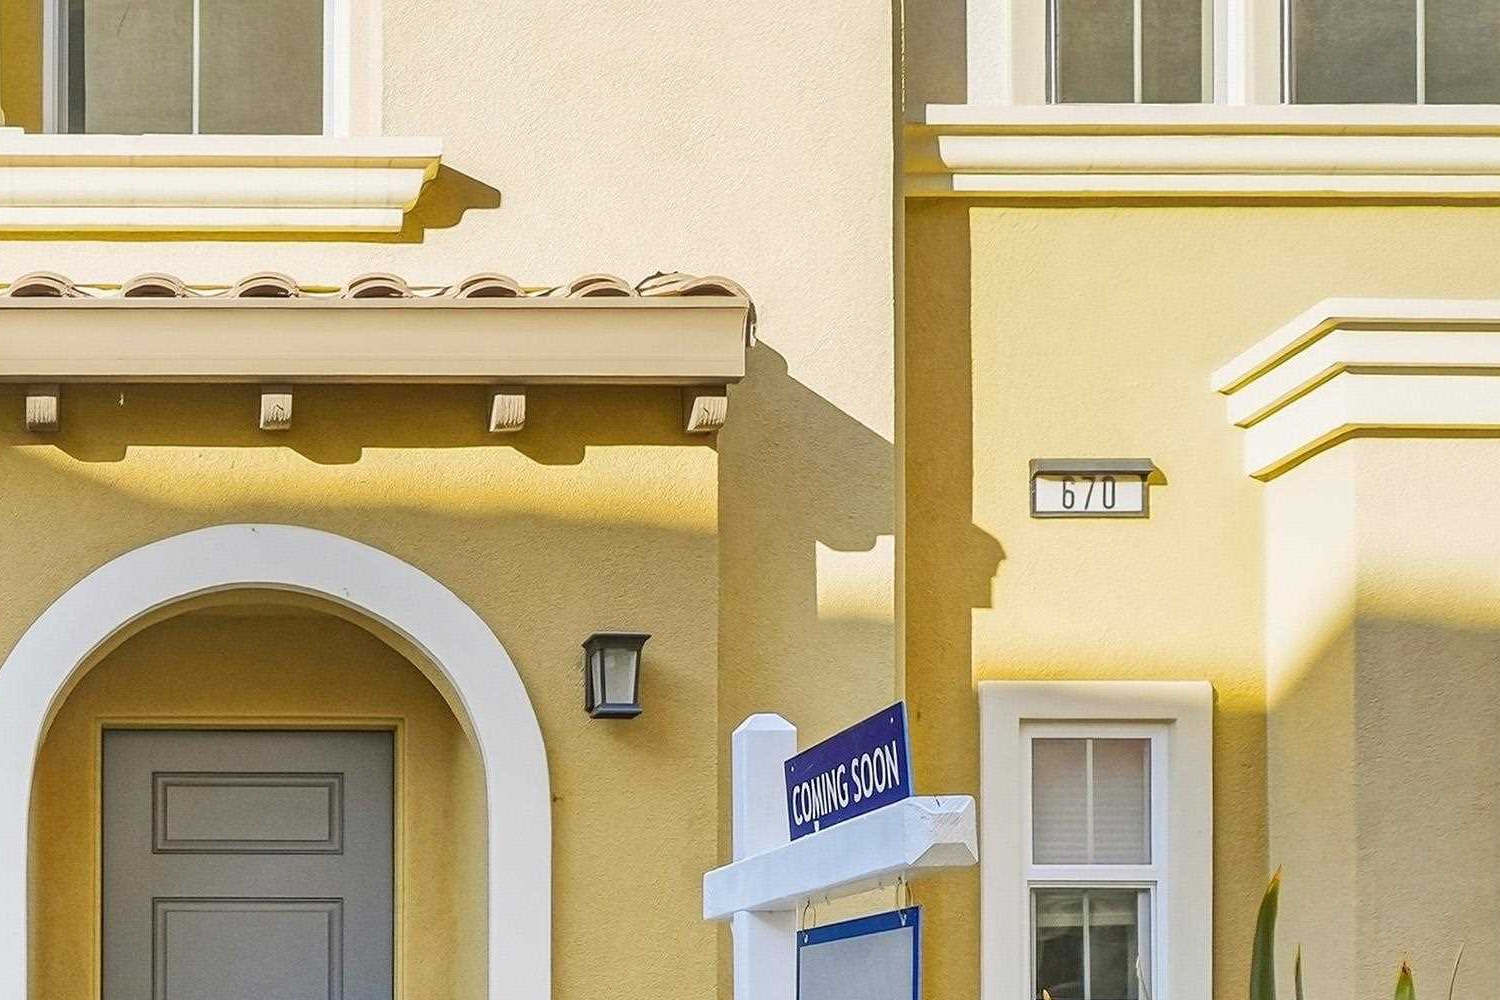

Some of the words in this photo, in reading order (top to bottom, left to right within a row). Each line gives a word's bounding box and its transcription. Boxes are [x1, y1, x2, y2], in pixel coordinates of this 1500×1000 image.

[1062, 475, 1116, 510] 670
[792, 763, 849, 826] COMING
[851, 740, 900, 803] SOON
